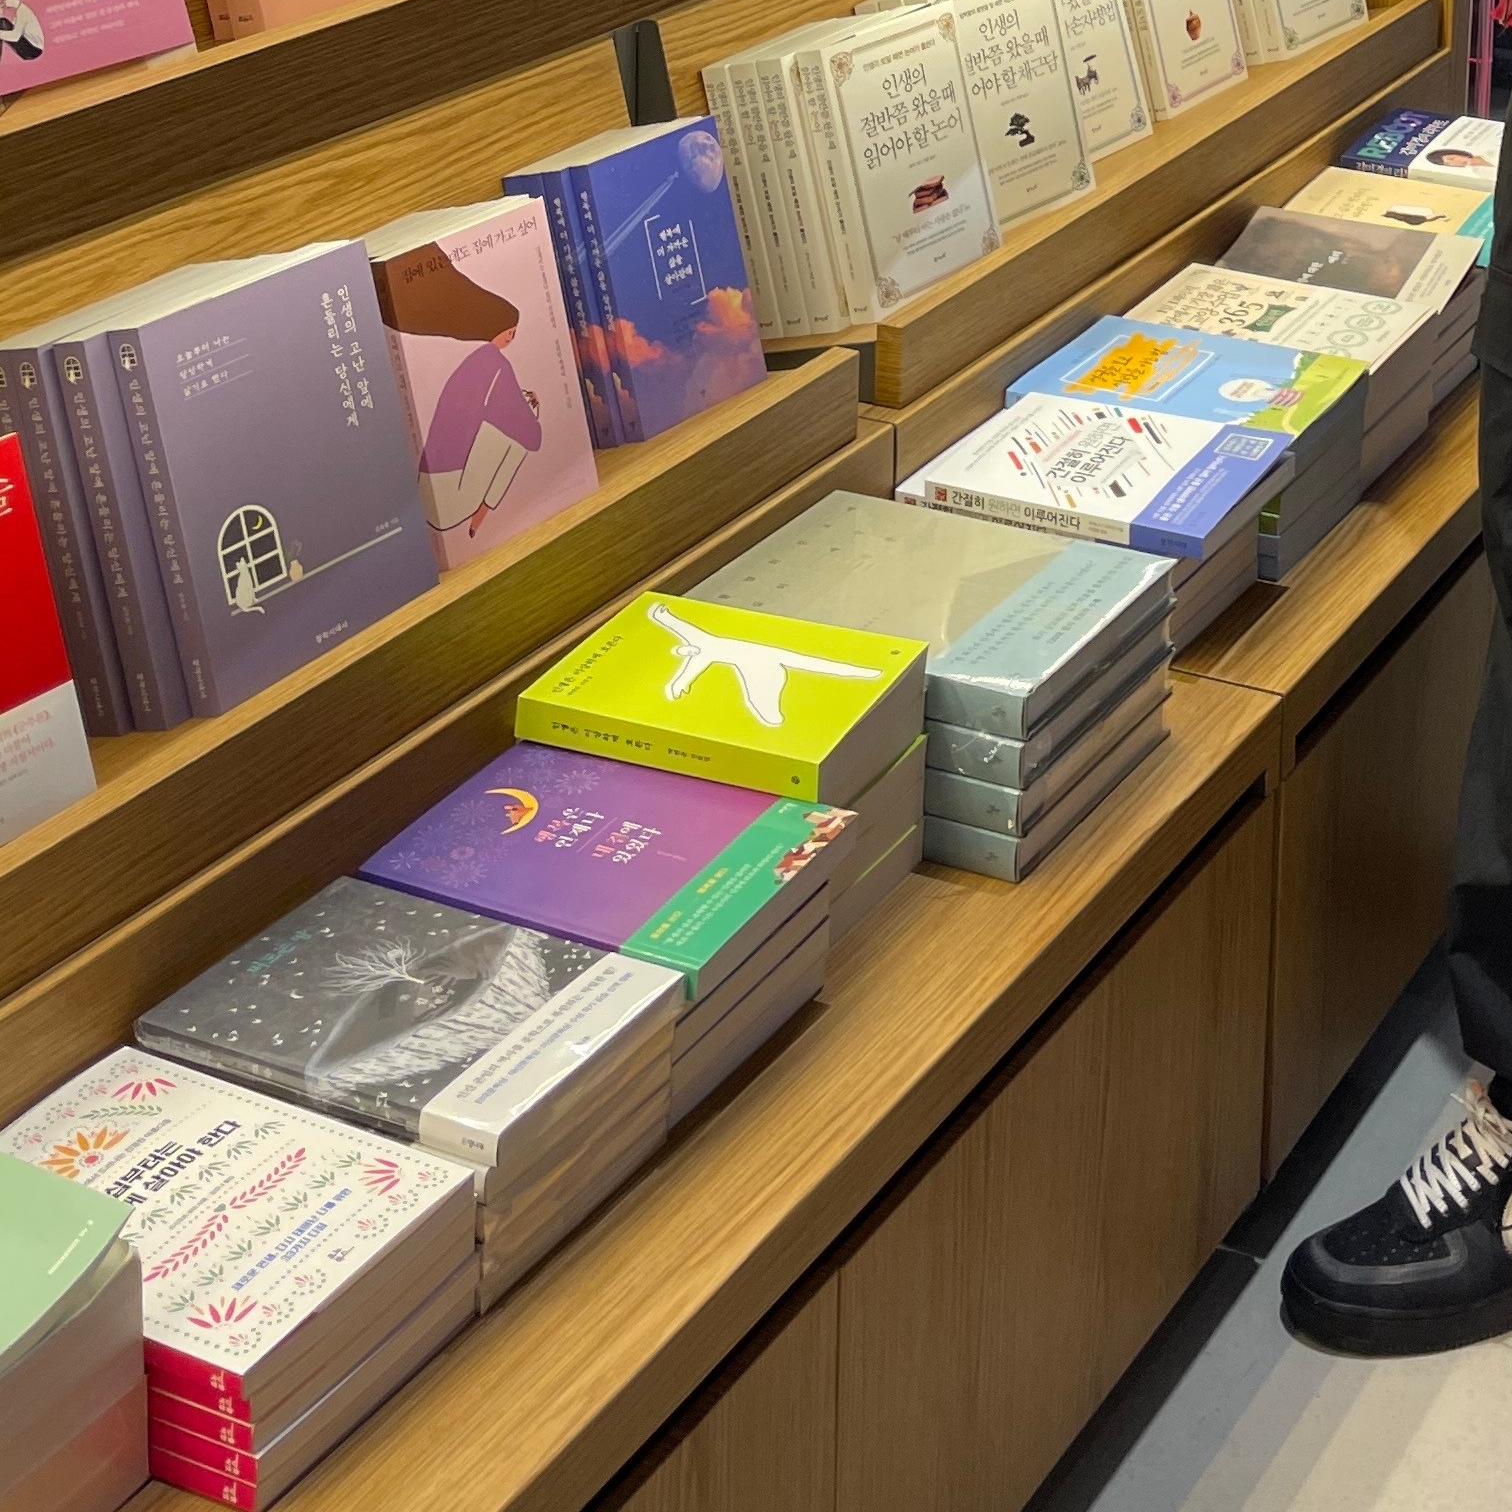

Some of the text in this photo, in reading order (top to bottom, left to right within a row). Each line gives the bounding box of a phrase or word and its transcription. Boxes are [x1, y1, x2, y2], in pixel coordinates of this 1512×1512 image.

[979, 9, 1021, 42] 인생의
[1070, 0, 1116, 37] 손자병법
[882, 62, 927, 99] 인생의
[1001, 49, 1059, 90] 할 채근담
[860, 101, 910, 138] 절반쯤
[863, 106, 964, 170] 읽어야 할 논어
[402, 216, 538, 284] 집에 있는데도 집에 가고 싶어
[1219, 301, 1264, 327] 365
[213, 335, 230, 347] 나는
[320, 292, 360, 428] 흔들리는 당신에게
[337, 284, 374, 409] 인생의 고난 앞에
[1046, 447, 1091, 480] 간절히
[1071, 436, 1135, 484] 이루어진다
[951, 490, 1081, 531] 간절히 원하면 이루어진다
[534, 806, 584, 843] 행복은
[554, 811, 605, 849] 언제나
[591, 820, 643, 858] 내 집에
[611, 826, 662, 865] 있었다
[144, 1149, 205, 1192] 살아야
[196, 1119, 243, 1148] 한다
